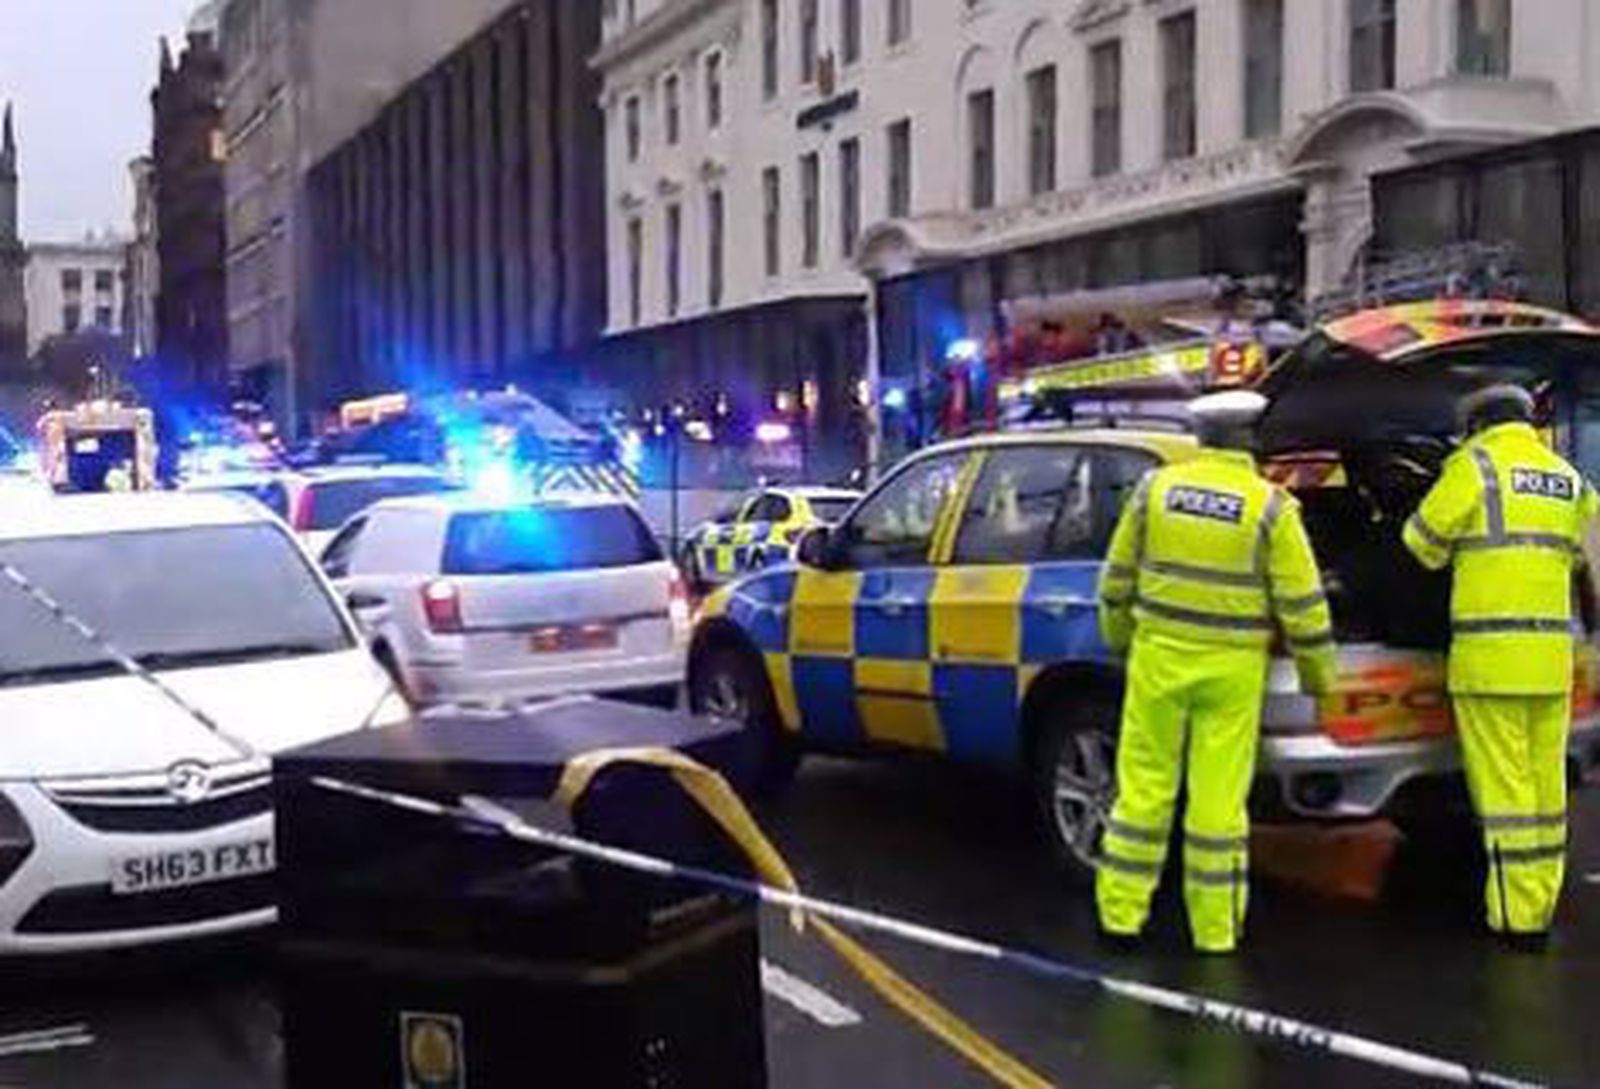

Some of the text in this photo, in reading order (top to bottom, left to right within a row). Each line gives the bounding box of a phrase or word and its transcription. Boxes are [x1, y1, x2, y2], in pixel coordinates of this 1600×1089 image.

[1166, 488, 1239, 518] POLICE
[123, 839, 270, 889] SH63 FXT
